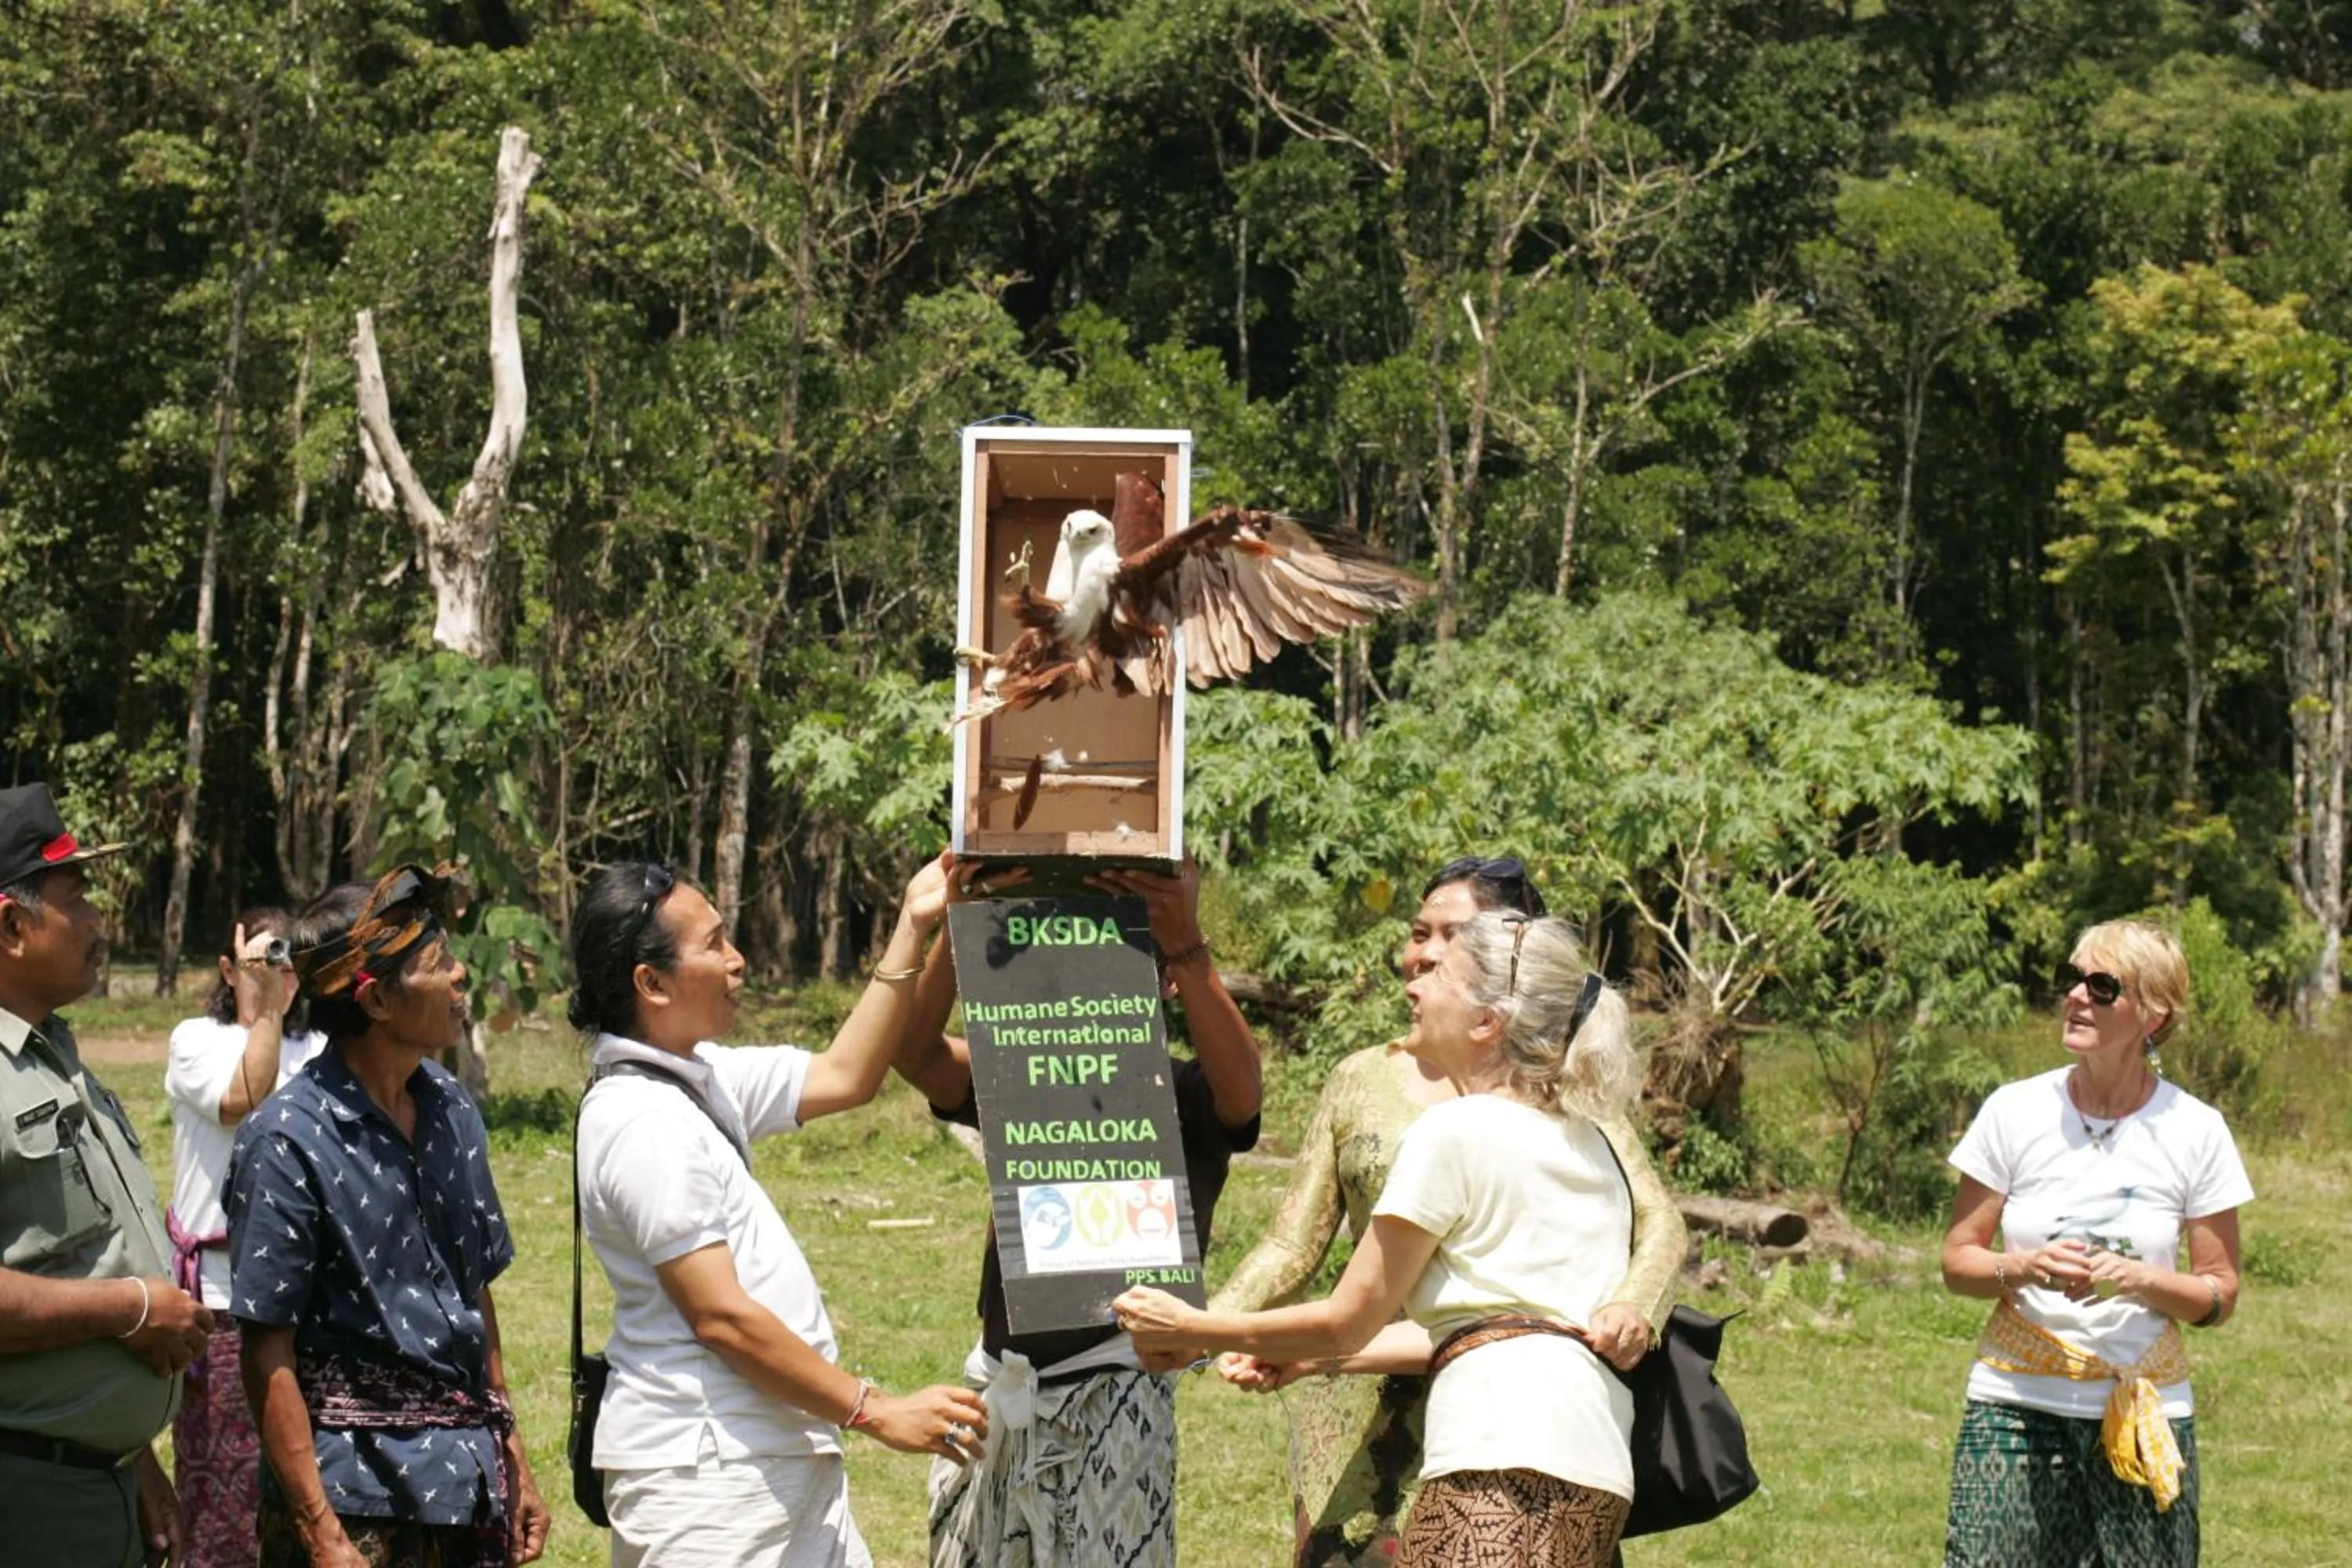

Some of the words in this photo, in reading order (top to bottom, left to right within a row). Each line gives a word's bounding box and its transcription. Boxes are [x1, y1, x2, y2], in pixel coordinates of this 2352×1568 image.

[1007, 916, 1124, 946] BKSDA
[965, 1001, 1067, 1022] Humane
[1070, 994, 1156, 1018] Society
[993, 1021, 1152, 1046] International
[1027, 1054, 1118, 1086] FNPF
[1005, 1118, 1157, 1145] NAGALOKA
[1006, 1160, 1161, 1179] FOUNDATION
[1125, 1269, 1157, 1285] PPS
[1160, 1269, 1196, 1283] BALI
